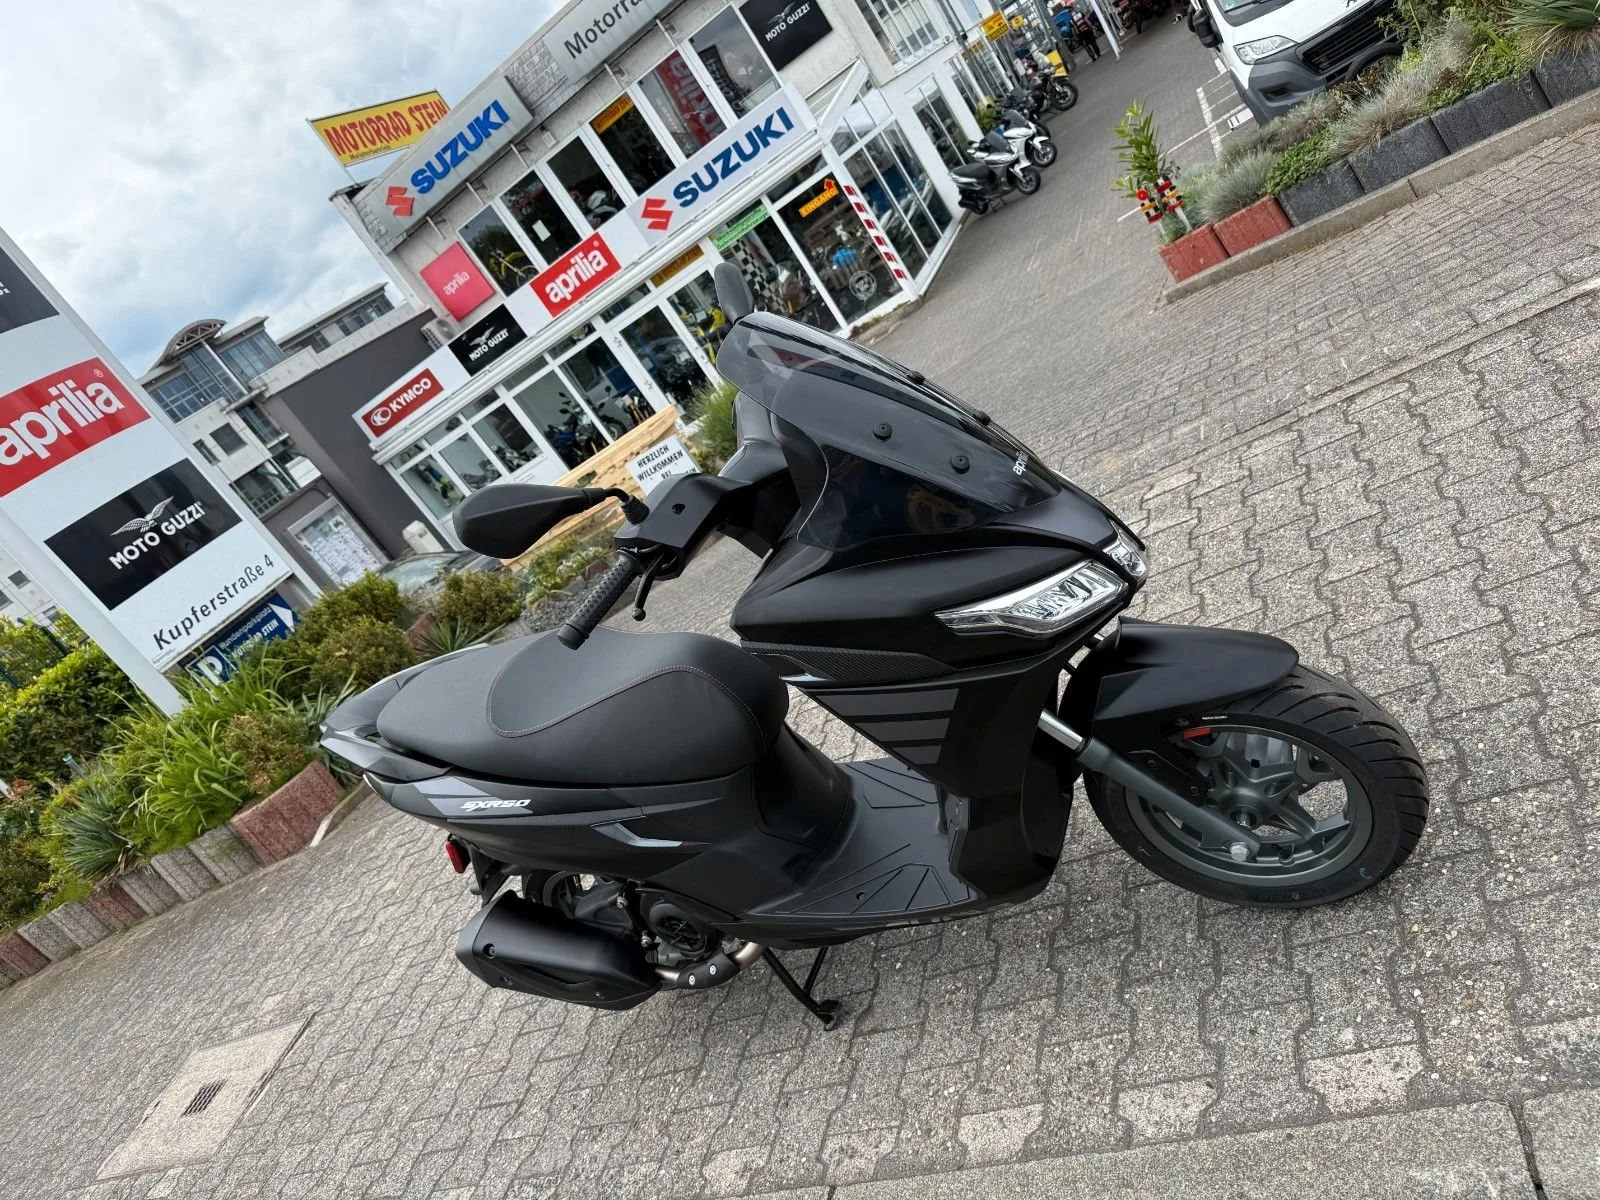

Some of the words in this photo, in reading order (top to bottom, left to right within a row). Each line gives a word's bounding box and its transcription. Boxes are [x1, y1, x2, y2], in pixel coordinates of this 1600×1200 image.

[765, 22, 786, 41] MOTO
[786, 3, 810, 24] GUZZI
[323, 110, 412, 156] MOTORRAD
[407, 99, 449, 132] STEIN
[411, 100, 510, 195] SUZUKI
[673, 107, 795, 208] SUZUKI
[443, 271, 471, 297] aprilia
[545, 247, 609, 306] aprilia
[469, 344, 488, 361] MOTO
[487, 328, 510, 348] GUZZI
[389, 378, 431, 412] KYMCO
[0, 379, 125, 466] aprilia
[637, 444, 669, 468] HERZLICH
[637, 449, 684, 481] WILLKOMMEN
[109, 534, 161, 570] MOTO
[160, 501, 206, 537] GUZZI
[153, 566, 265, 651] Kupferstraße
[263, 553, 275, 569] 4
[261, 618, 280, 637] STEIN
[196, 655, 223, 686] P
[460, 799, 531, 812] SXR50
